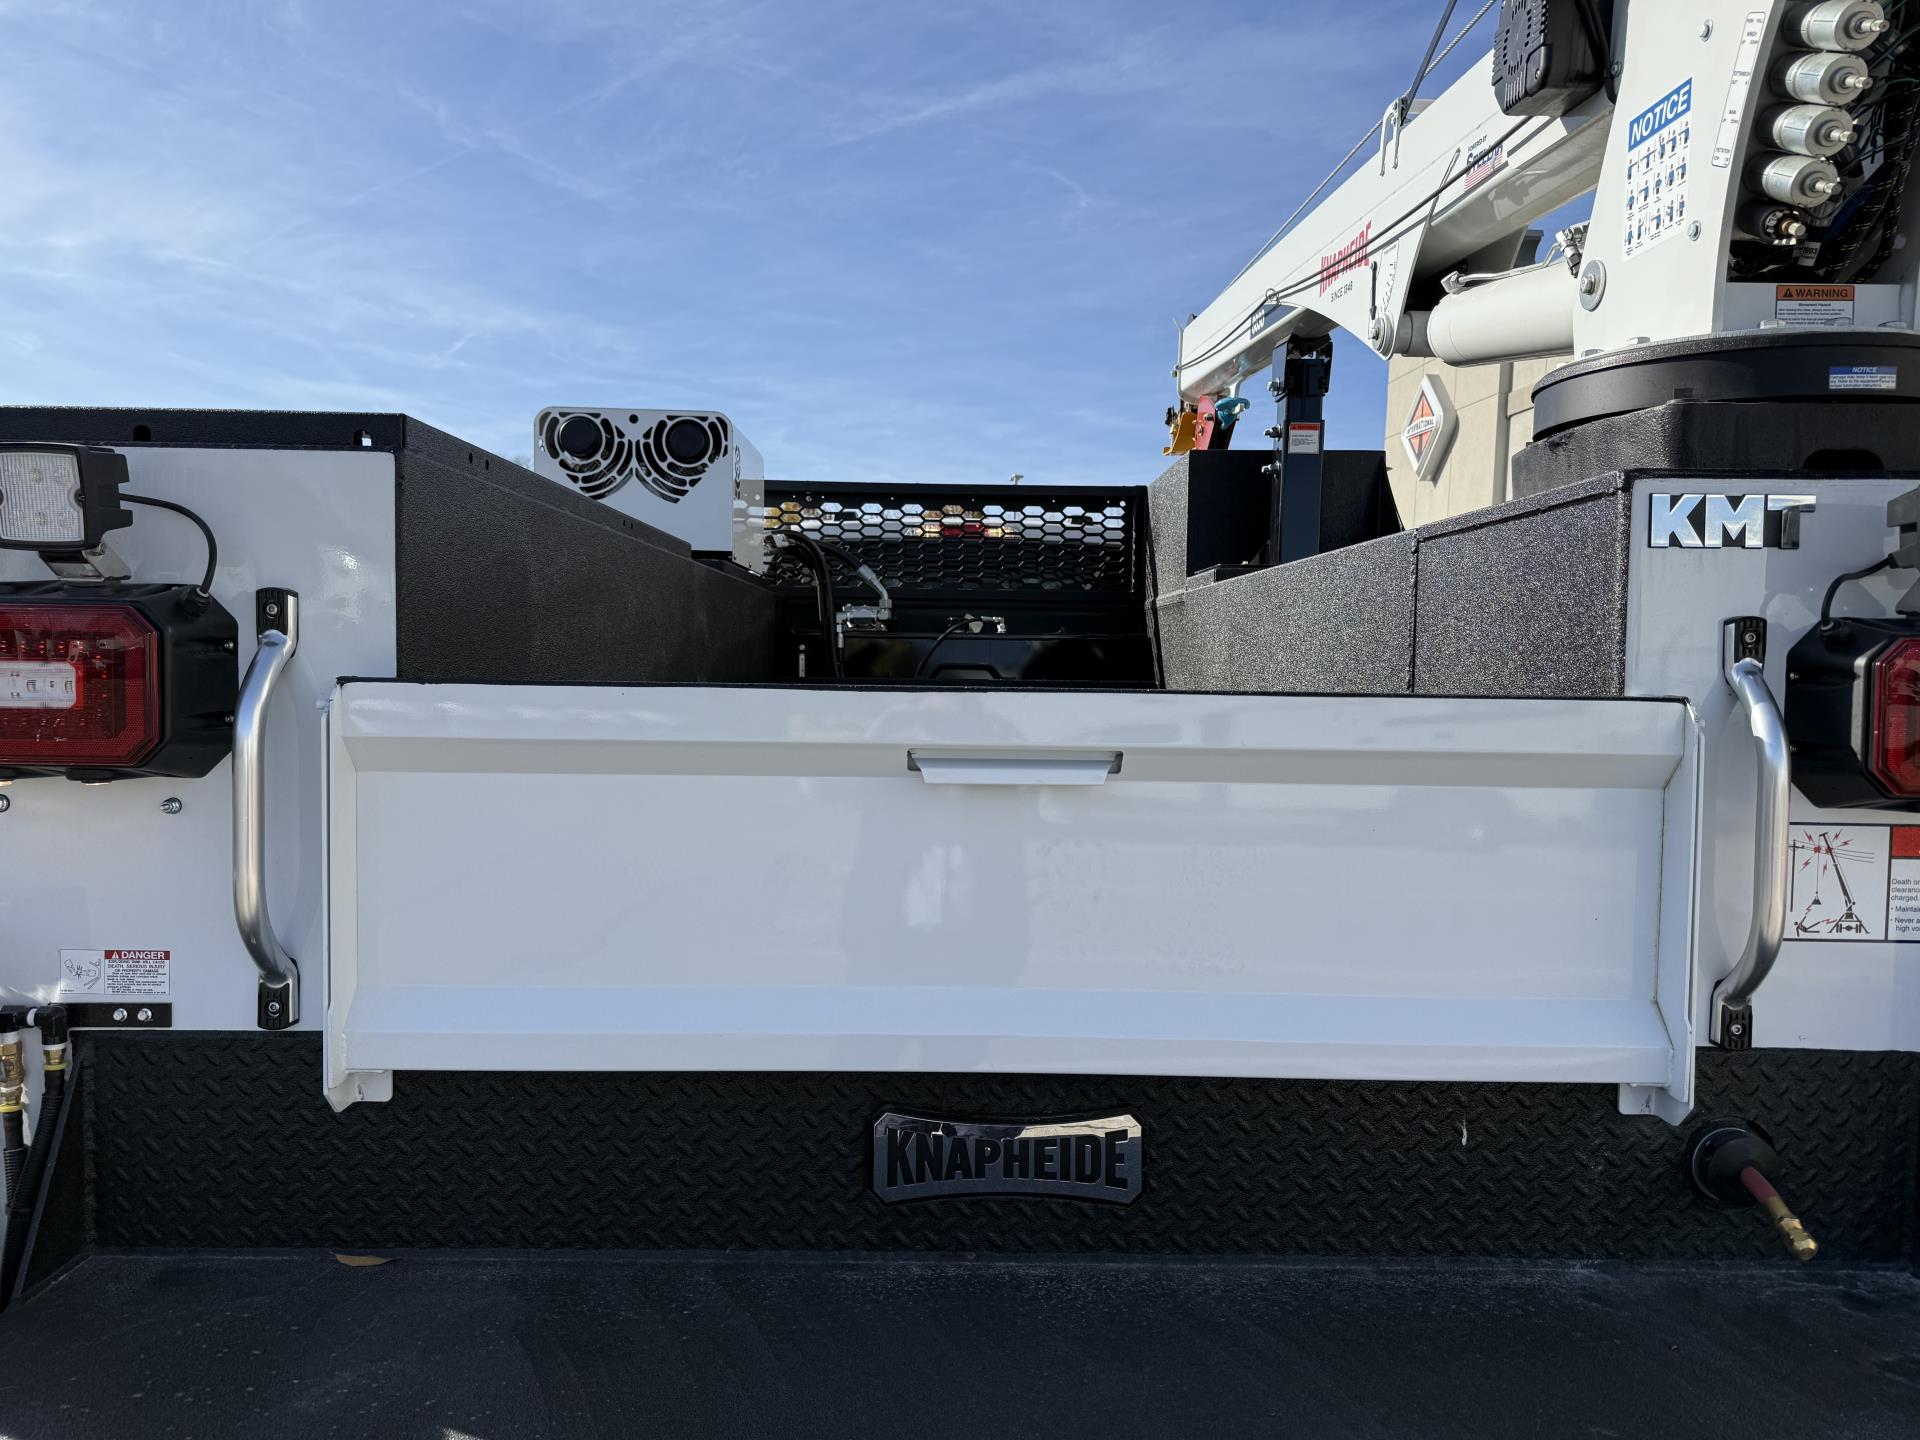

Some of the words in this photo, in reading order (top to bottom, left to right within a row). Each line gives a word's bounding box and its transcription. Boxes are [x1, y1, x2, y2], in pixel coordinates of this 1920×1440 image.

[1630, 84, 1691, 147] NOTICE
[1319, 220, 1371, 297] KNAPHEIDE
[1330, 286, 1344, 303] SINCE
[1795, 288, 1848, 298] WARNING
[1648, 493, 1817, 549] KMT
[1895, 924, 1910, 933] high
[121, 951, 165, 960] DANGER
[886, 1127, 1129, 1191] KNAPHEIDE
